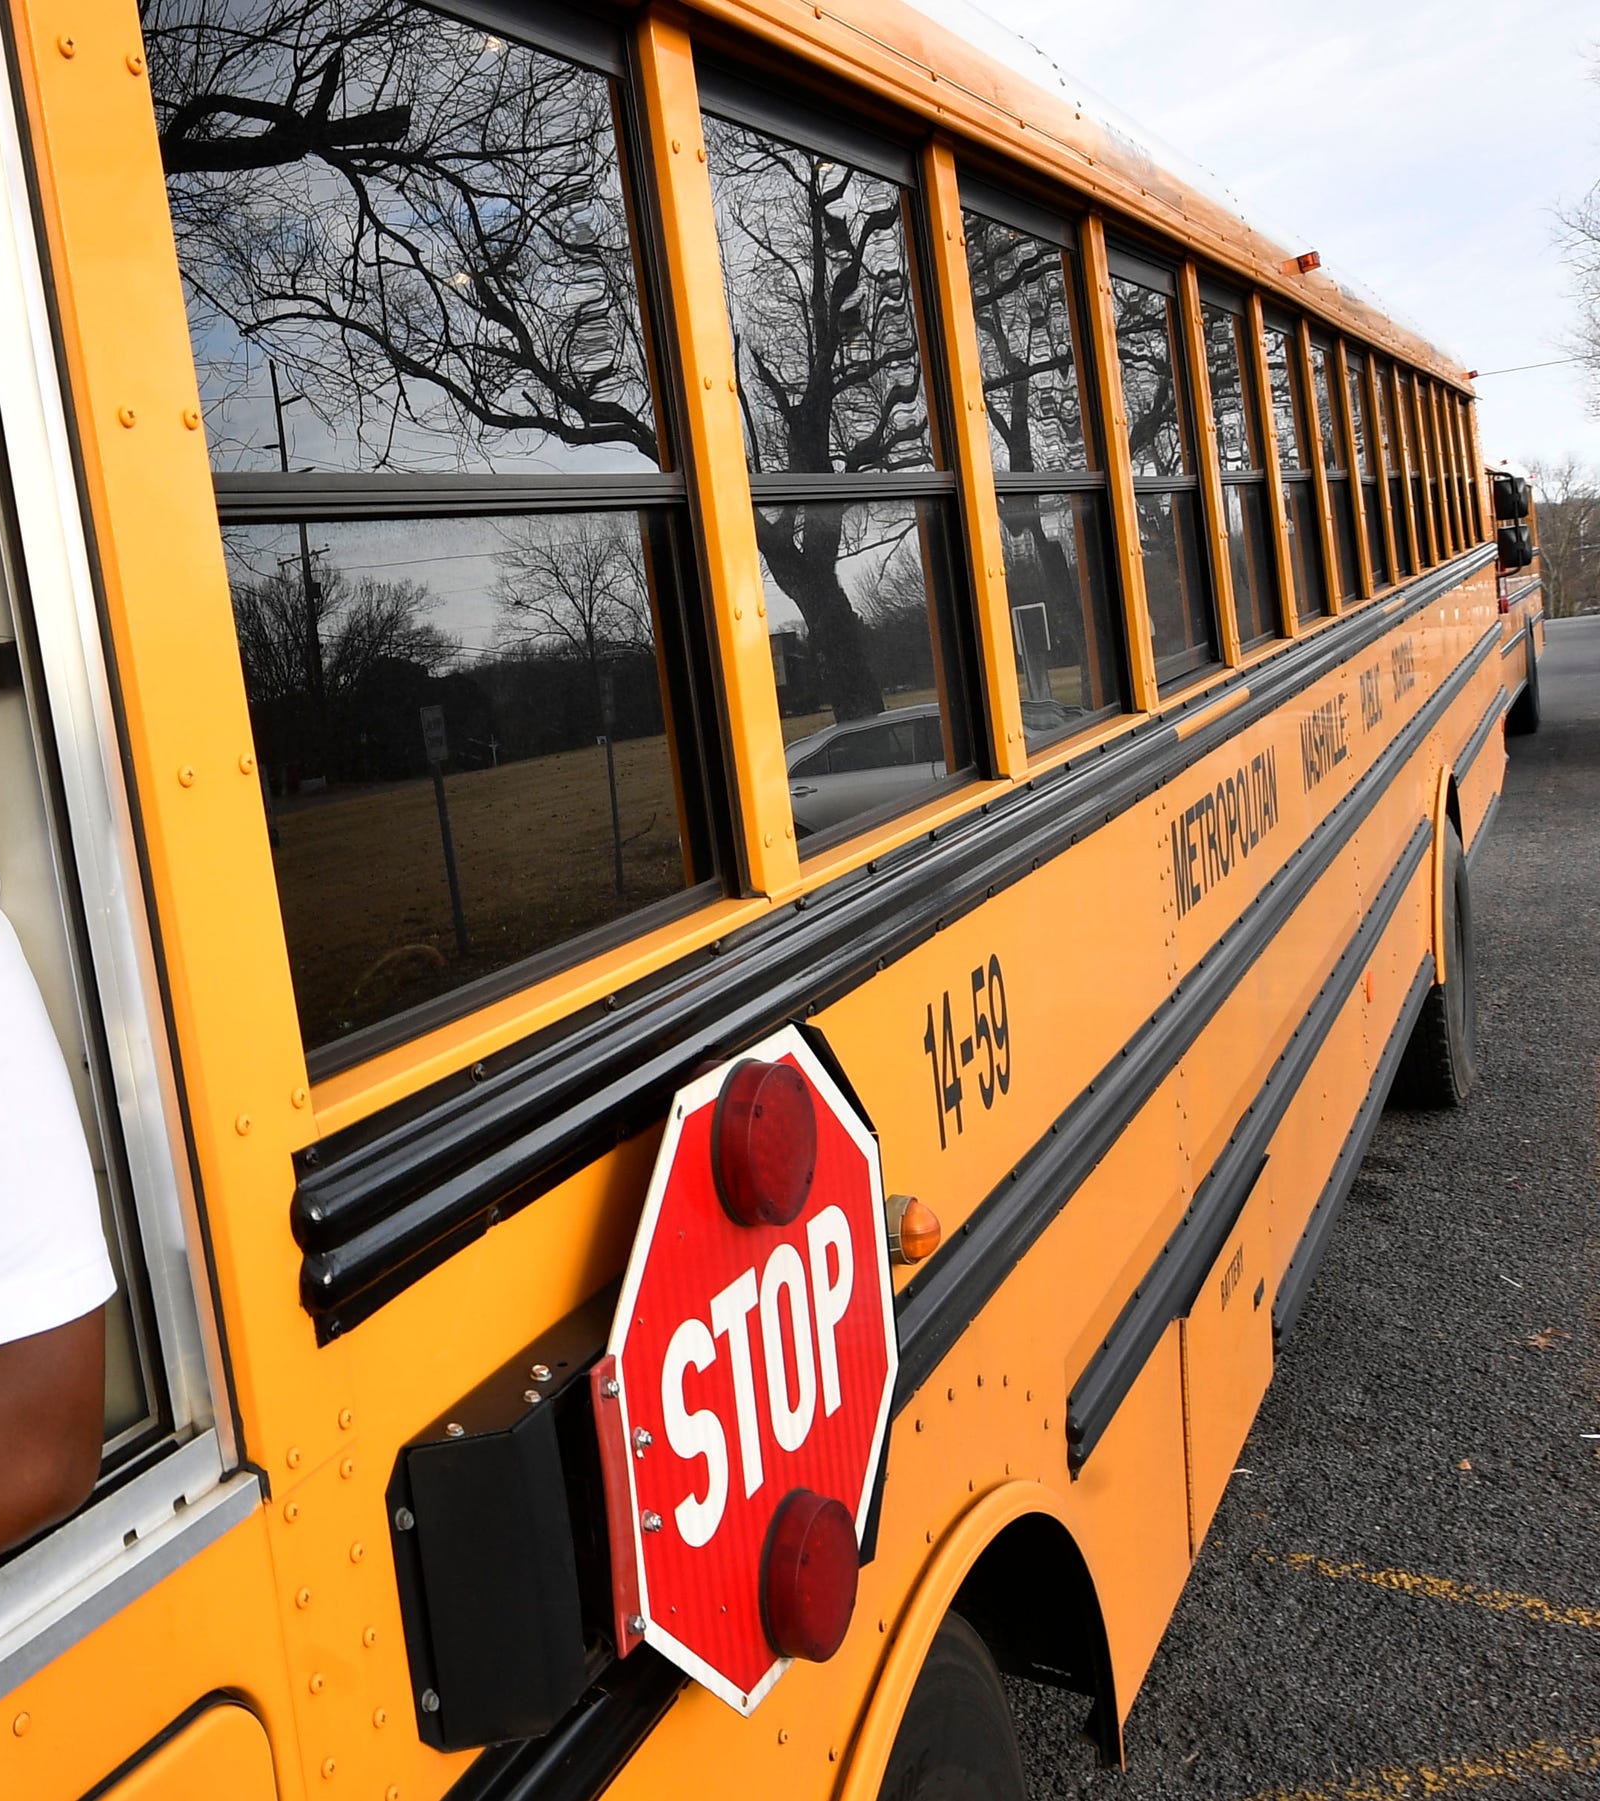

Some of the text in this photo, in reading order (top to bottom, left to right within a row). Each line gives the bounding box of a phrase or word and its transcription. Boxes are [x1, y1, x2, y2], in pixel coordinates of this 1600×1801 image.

[1170, 745, 1279, 920] METROPOLITAN
[1300, 693, 1347, 794] NASHVILLE
[924, 953, 1010, 1152] 14-59
[661, 1204, 855, 1548] STOP
[1221, 1243, 1243, 1312] BATTERY
